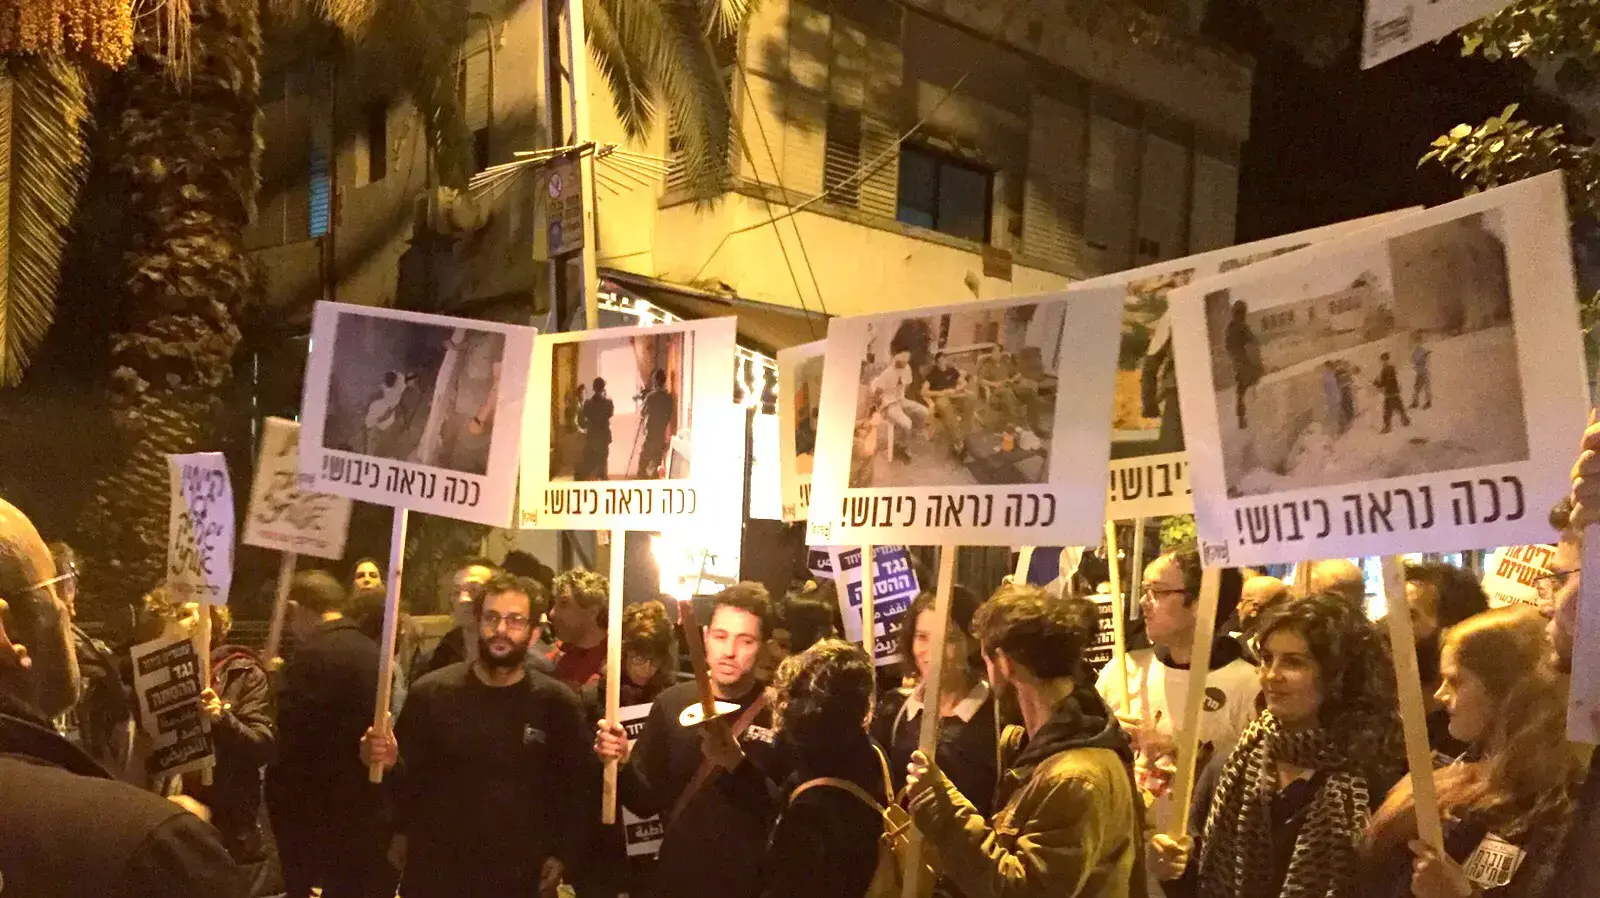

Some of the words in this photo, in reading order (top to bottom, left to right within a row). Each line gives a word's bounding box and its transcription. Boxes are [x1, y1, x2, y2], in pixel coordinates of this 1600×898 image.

[322, 455, 381, 488] כיבוש!
[385, 466, 437, 499] נראה
[1110, 461, 1192, 502] יבוש!
[443, 476, 481, 507] ככה
[544, 488, 598, 514] כיבוש!
[605, 488, 651, 514] נראה
[662, 488, 696, 514] ככה
[1452, 474, 1525, 526] ככה
[841, 495, 917, 527] כיבוש!
[925, 494, 994, 527] נראה
[1004, 493, 1056, 527] ככה
[1235, 499, 1330, 546] כיבוש!
[1342, 486, 1434, 537] נראה
[881, 557, 909, 575] נגד
[854, 575, 911, 601] ההסה
[172, 661, 194, 679] נגד
